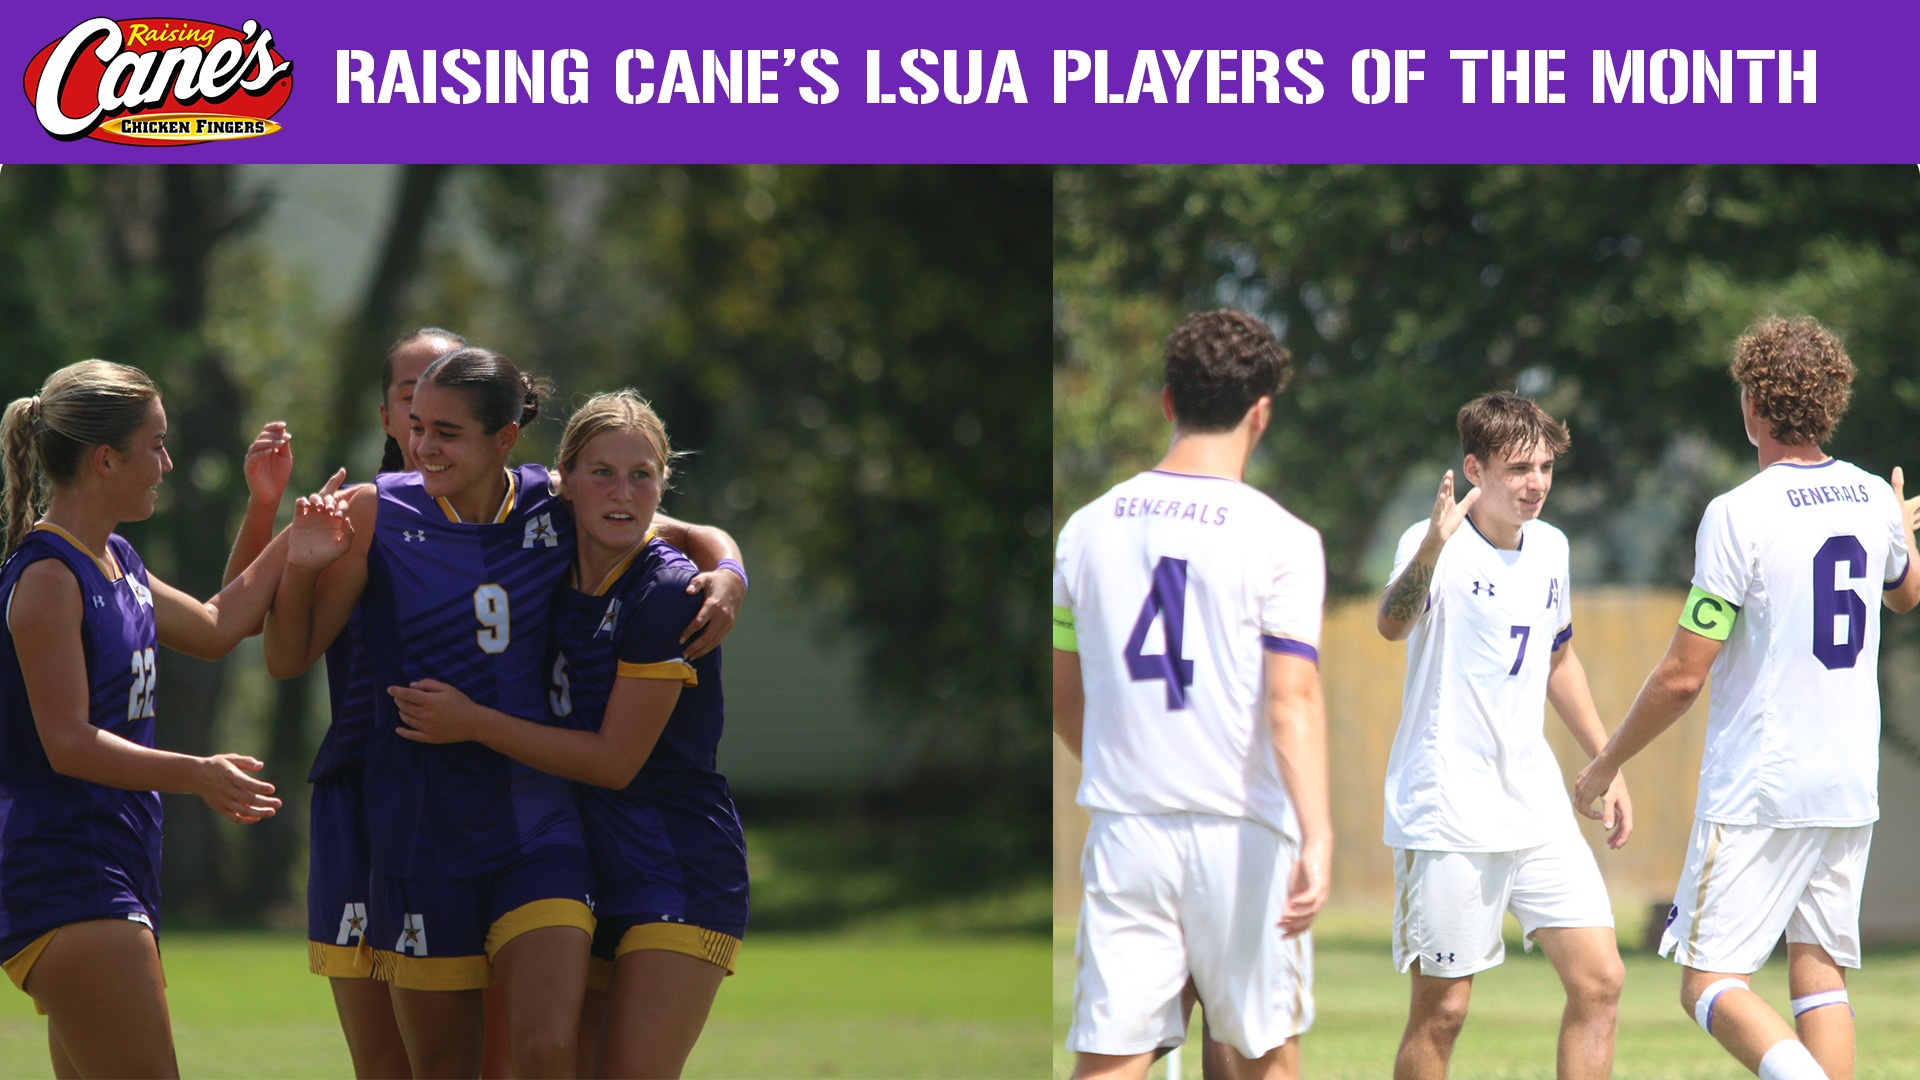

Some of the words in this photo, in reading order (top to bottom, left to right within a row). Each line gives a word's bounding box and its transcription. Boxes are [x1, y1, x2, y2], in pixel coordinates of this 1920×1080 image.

[1114, 497, 1229, 526] GENERALS
[1786, 484, 1869, 508] GENERALS
[473, 583, 511, 655] 9
[1692, 597, 1723, 630] C
[1813, 535, 1867, 670] 6
[1123, 555, 1195, 713] 4
[1509, 625, 1530, 676] 7
[128, 647, 157, 722] 22
